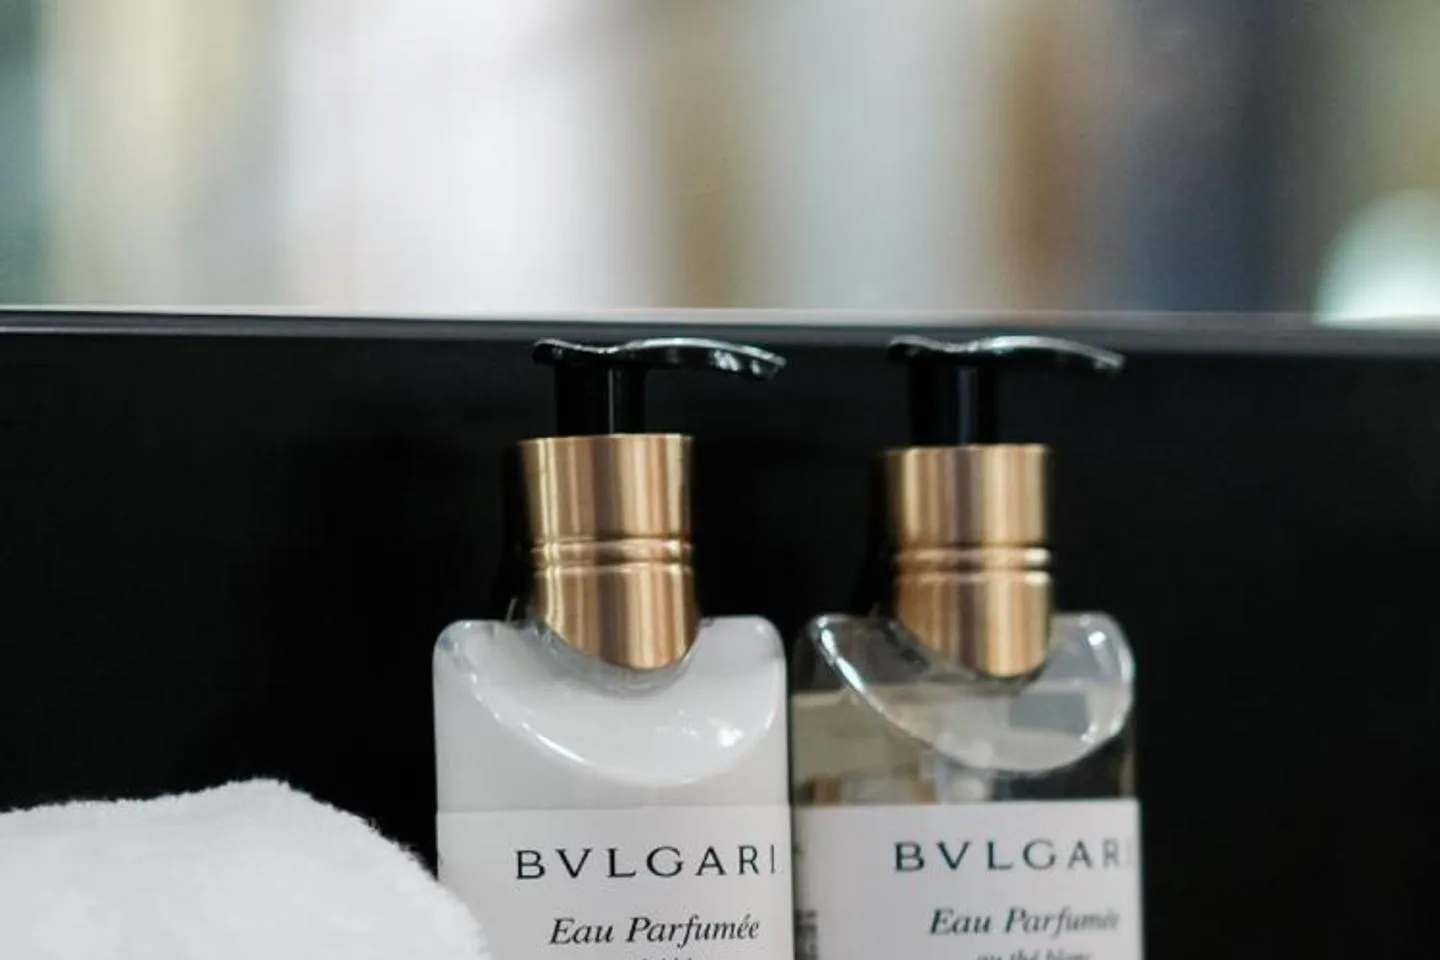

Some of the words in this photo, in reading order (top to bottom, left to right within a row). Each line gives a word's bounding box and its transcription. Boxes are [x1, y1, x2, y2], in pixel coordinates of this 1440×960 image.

[514, 843, 776, 880] BVLGARI
[893, 837, 1133, 873] BVLGAR
[549, 917, 614, 945] Eau
[625, 913, 761, 949] Parfumée
[929, 907, 991, 936] Eau
